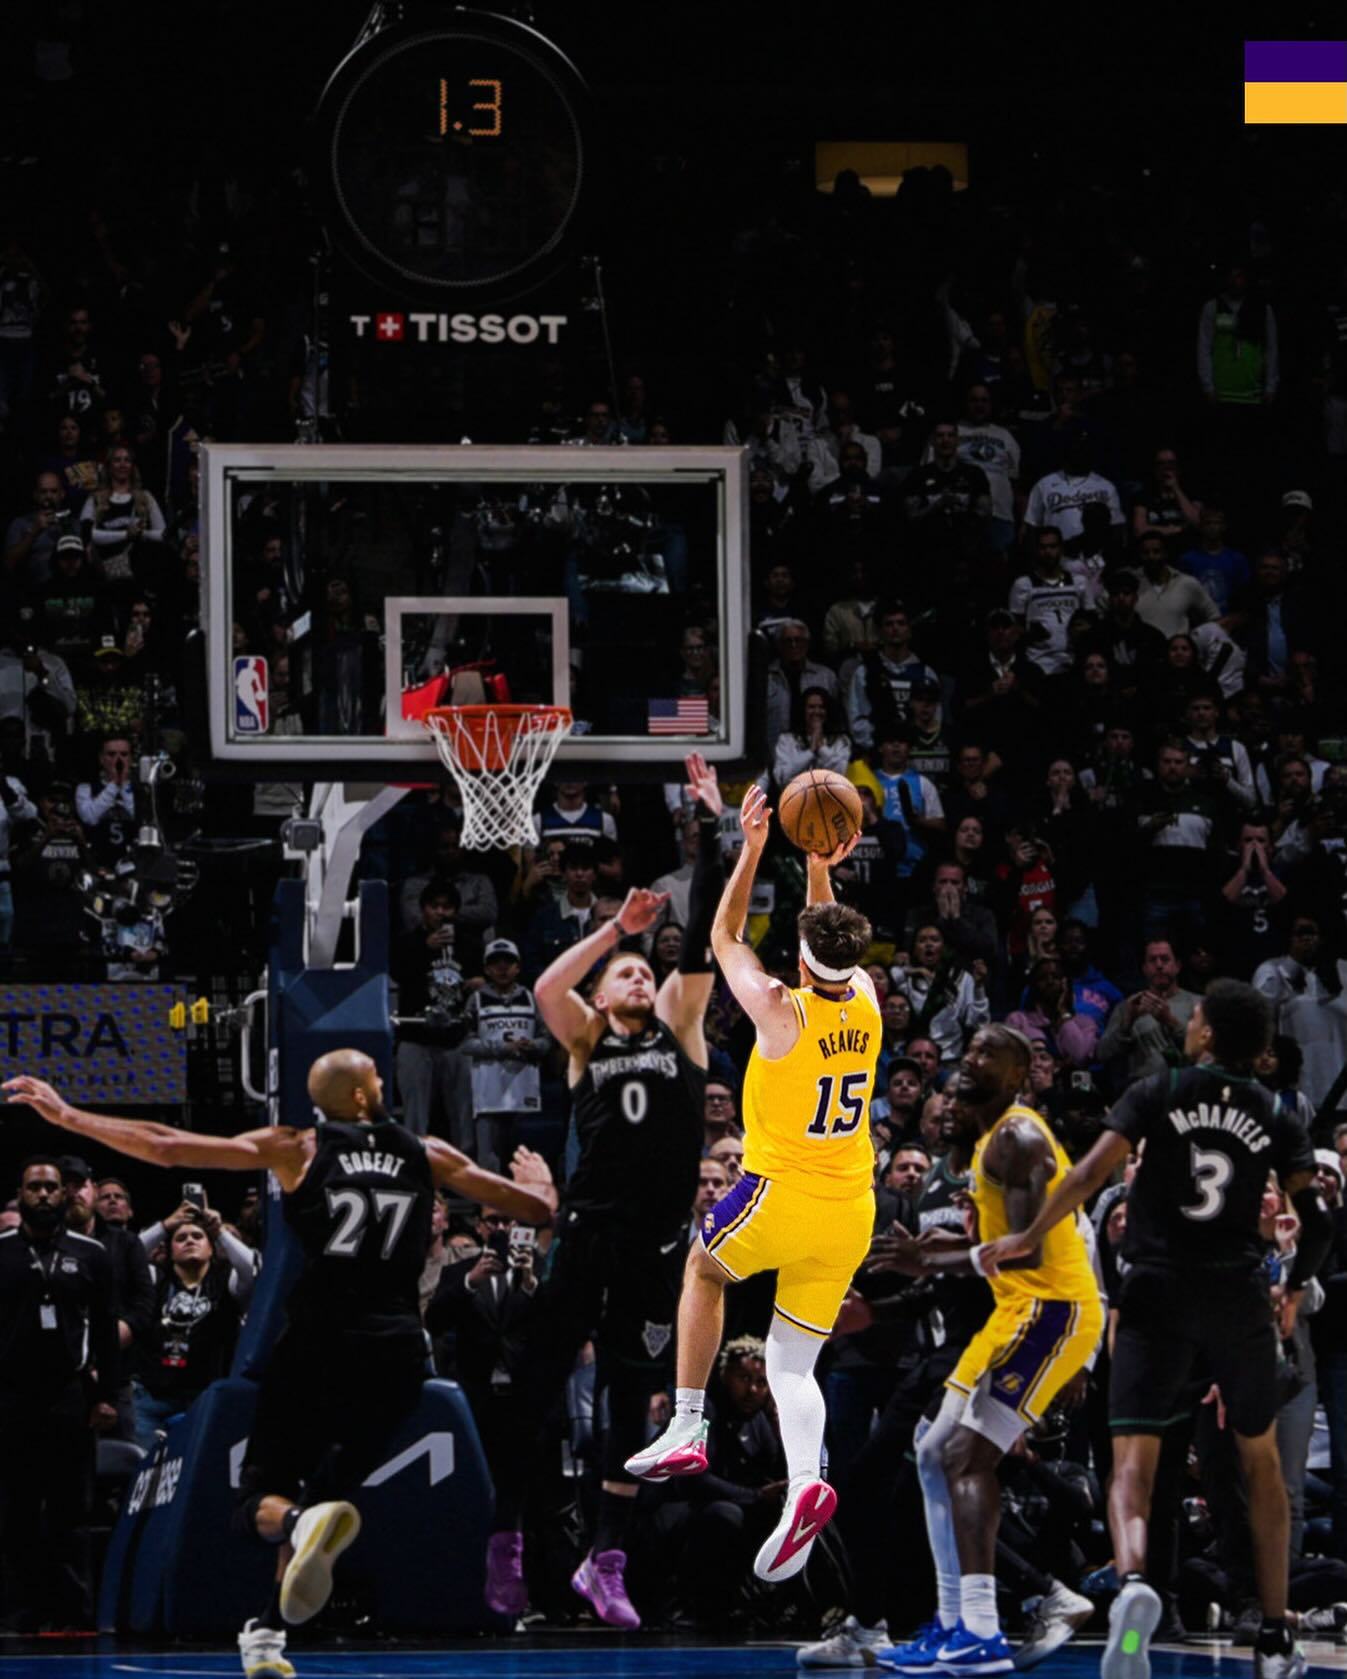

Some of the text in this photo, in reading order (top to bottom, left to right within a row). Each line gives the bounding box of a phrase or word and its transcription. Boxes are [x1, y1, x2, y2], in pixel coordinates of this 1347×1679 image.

[439, 77, 504, 137] 1.3
[408, 312, 568, 345] TISSOT
[68, 390, 93, 414] 19
[108, 822, 125, 845] 5
[1252, 908, 1270, 934] 5
[487, 1019, 529, 1031] WOLVES
[818, 1028, 870, 1060] REAVES
[588, 1050, 680, 1093] TIMBERWOLVES
[620, 1080, 649, 1125] 0
[805, 1071, 869, 1137] 15
[1167, 1102, 1272, 1153] McDANIELS
[338, 1151, 406, 1178] GOBERT
[1179, 1140, 1235, 1222] 3
[323, 1186, 419, 1261] 27
